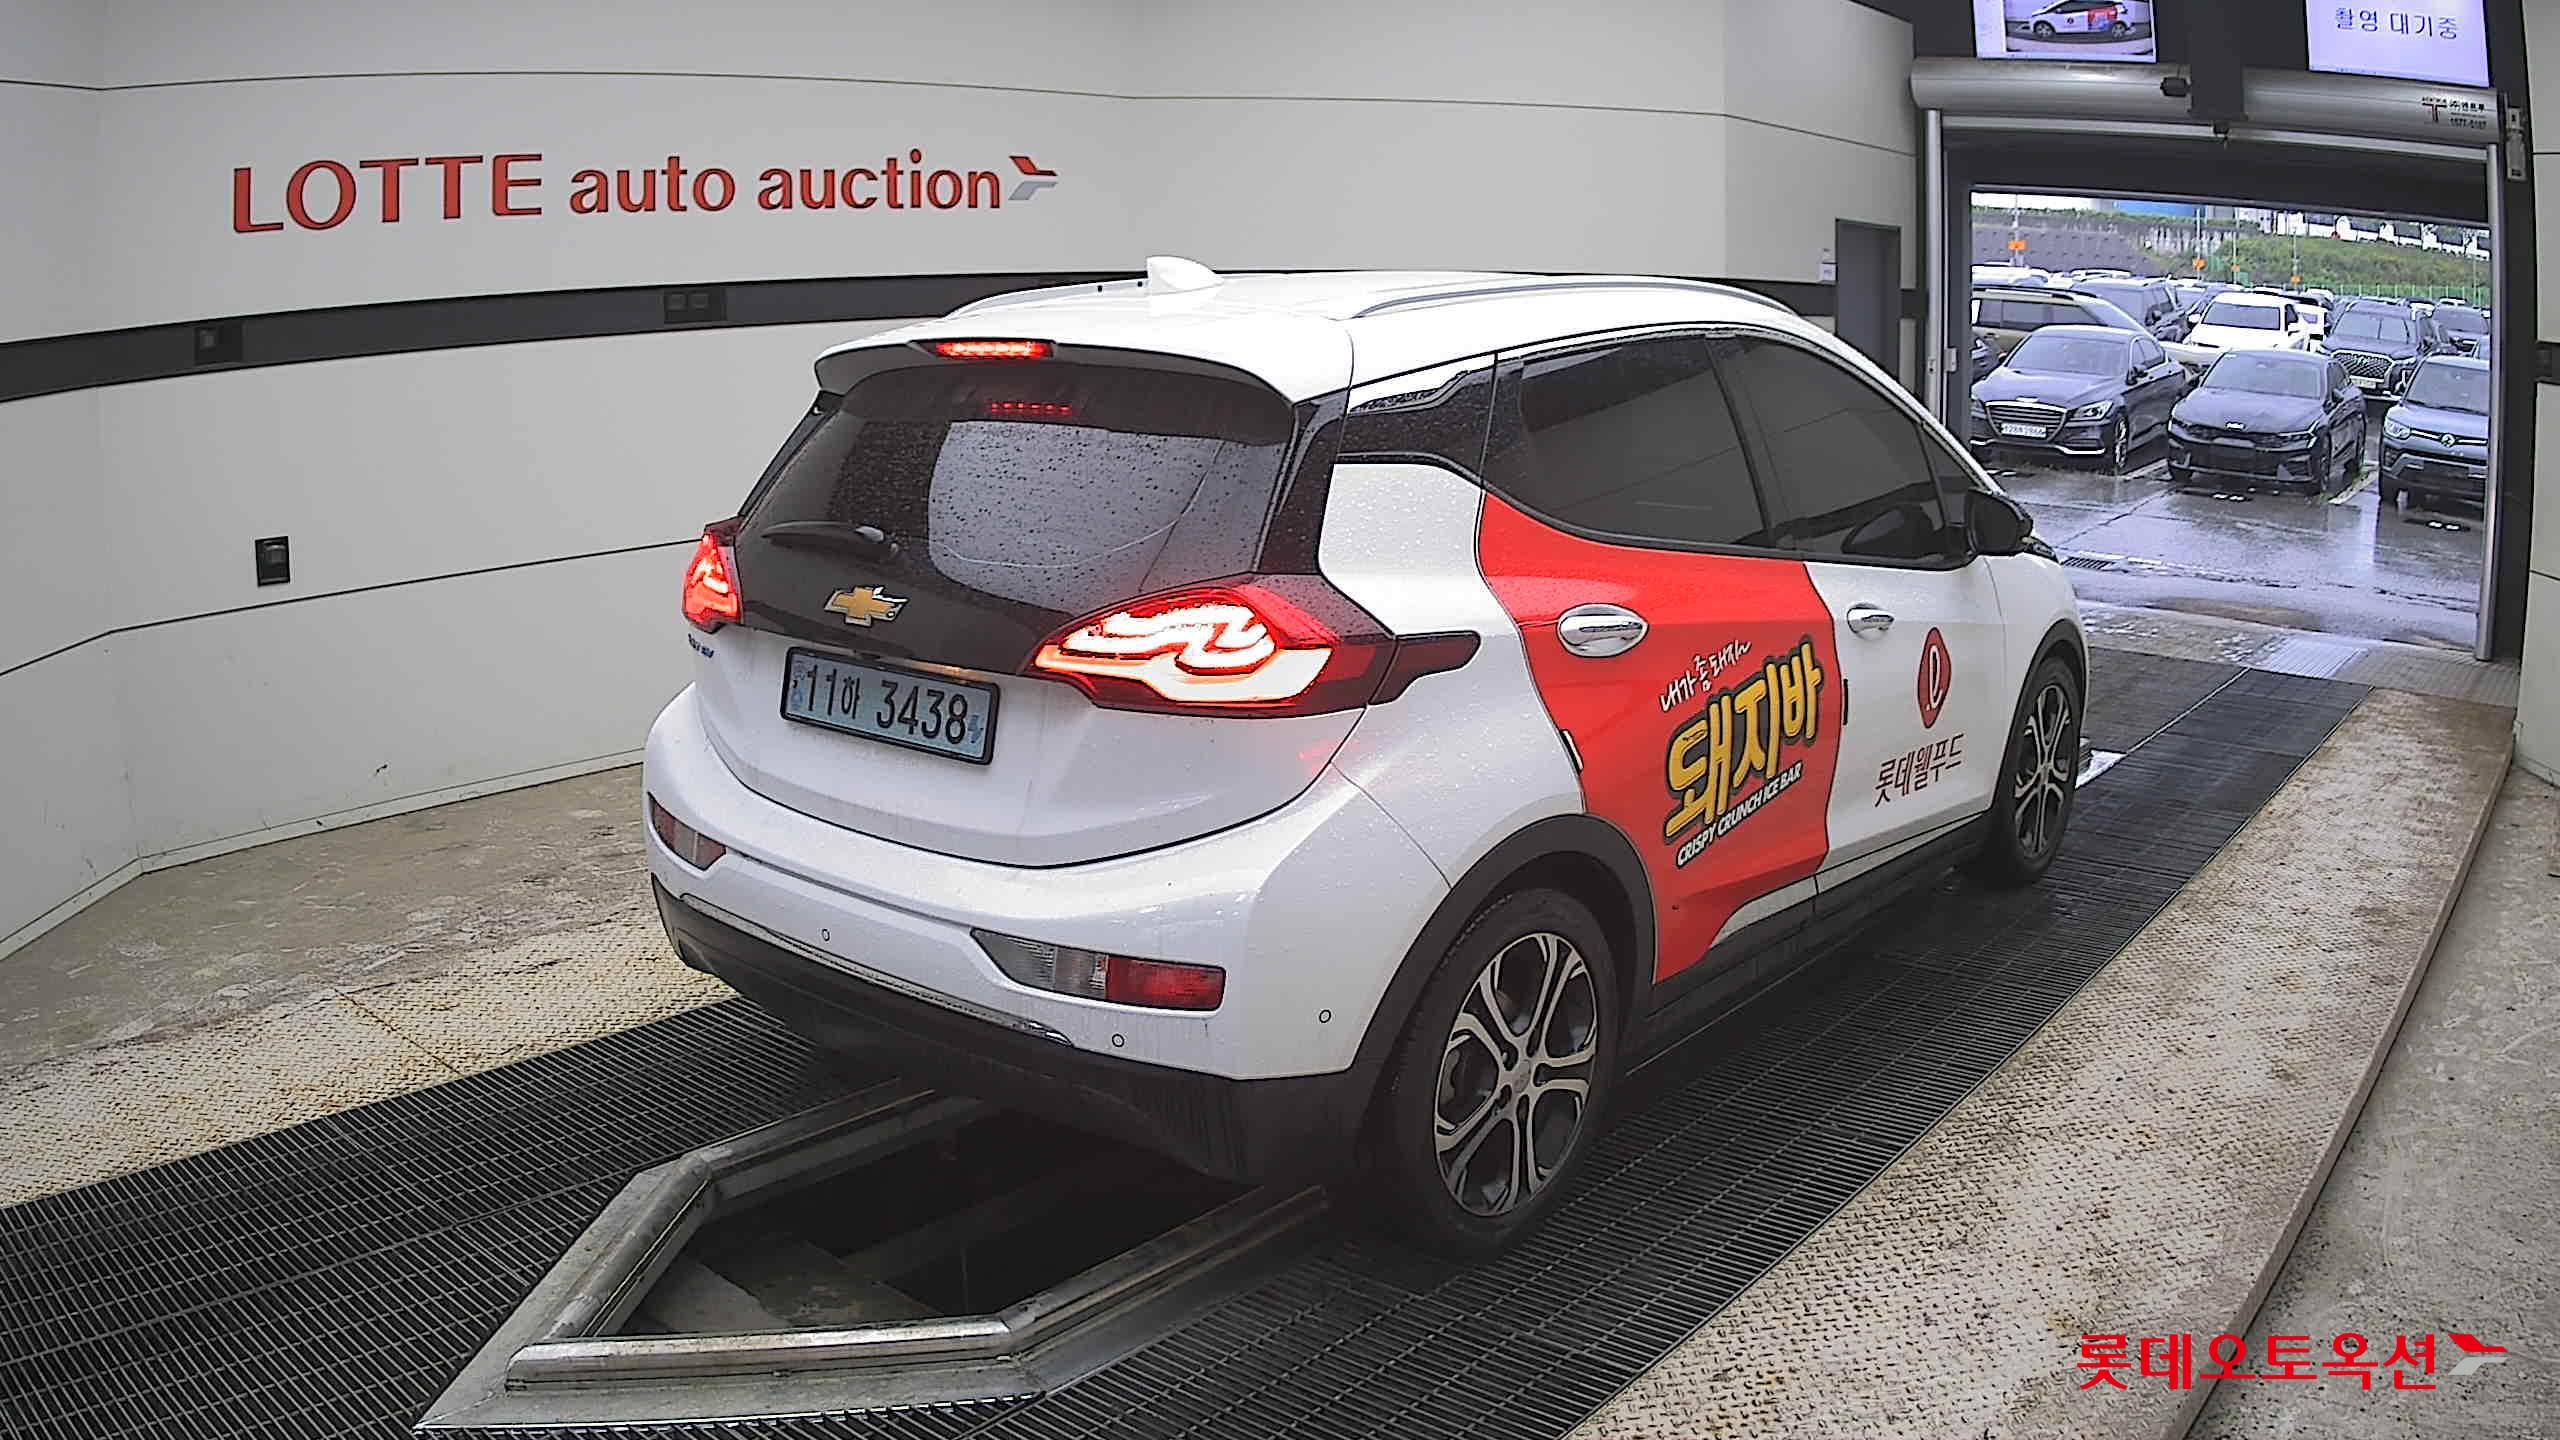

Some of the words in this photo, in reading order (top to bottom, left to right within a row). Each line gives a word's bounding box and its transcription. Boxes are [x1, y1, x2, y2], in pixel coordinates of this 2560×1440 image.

[2336, 7, 2379, 32] 촬영
[2390, 12, 2457, 40] 대기중
[232, 153, 546, 233] LOTTE
[568, 155, 738, 216] auto
[755, 148, 1003, 212] auction
[807, 664, 860, 719] 11하
[876, 679, 968, 744] 3438
[1665, 643, 1821, 838] 돼지바
[1874, 733, 1964, 807] 롯데웰푸드
[1677, 822, 1717, 867] CRISPY
[1716, 789, 1763, 836] CRUNCH
[1762, 777, 1781, 803] ICE
[1779, 761, 1802, 790] BAR
